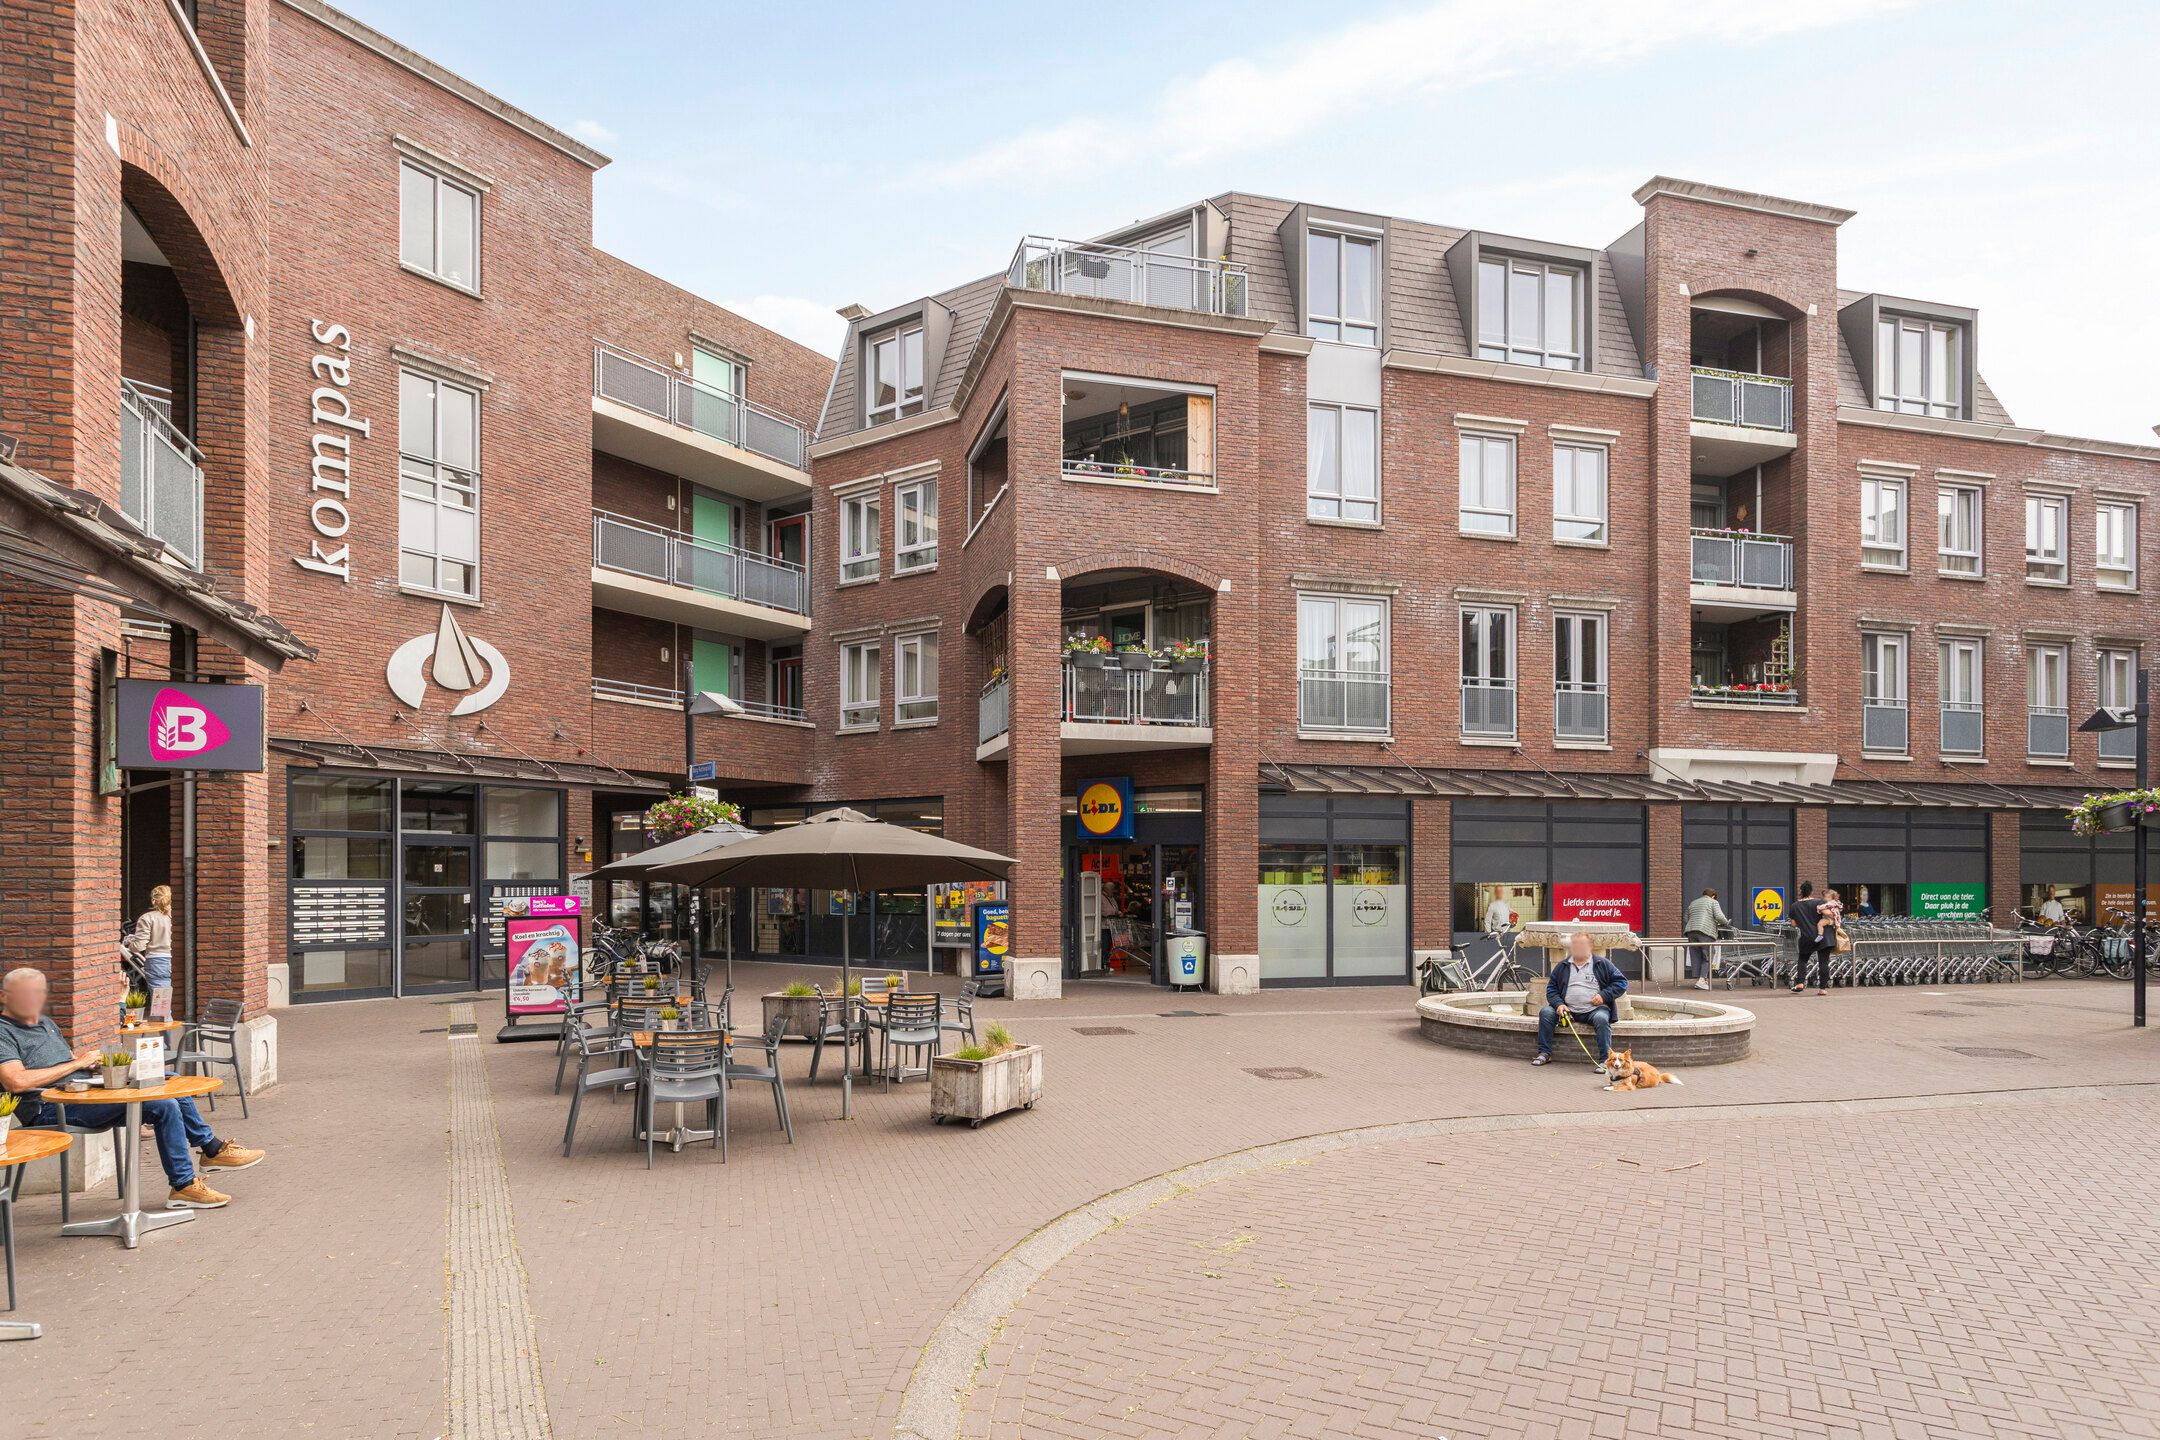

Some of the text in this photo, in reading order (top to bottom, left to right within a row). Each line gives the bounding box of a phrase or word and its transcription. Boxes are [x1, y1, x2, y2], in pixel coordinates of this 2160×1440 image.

[291, 318, 370, 583] kompas
[1119, 632, 1140, 642] HOME
[161, 706, 207, 751] B
[1563, 898, 1631, 907] Liefde en aandacht,
[1940, 902, 1954, 910] pluk
[1954, 902, 1960, 910] je
[1579, 908, 1622, 917] dat proef je.
